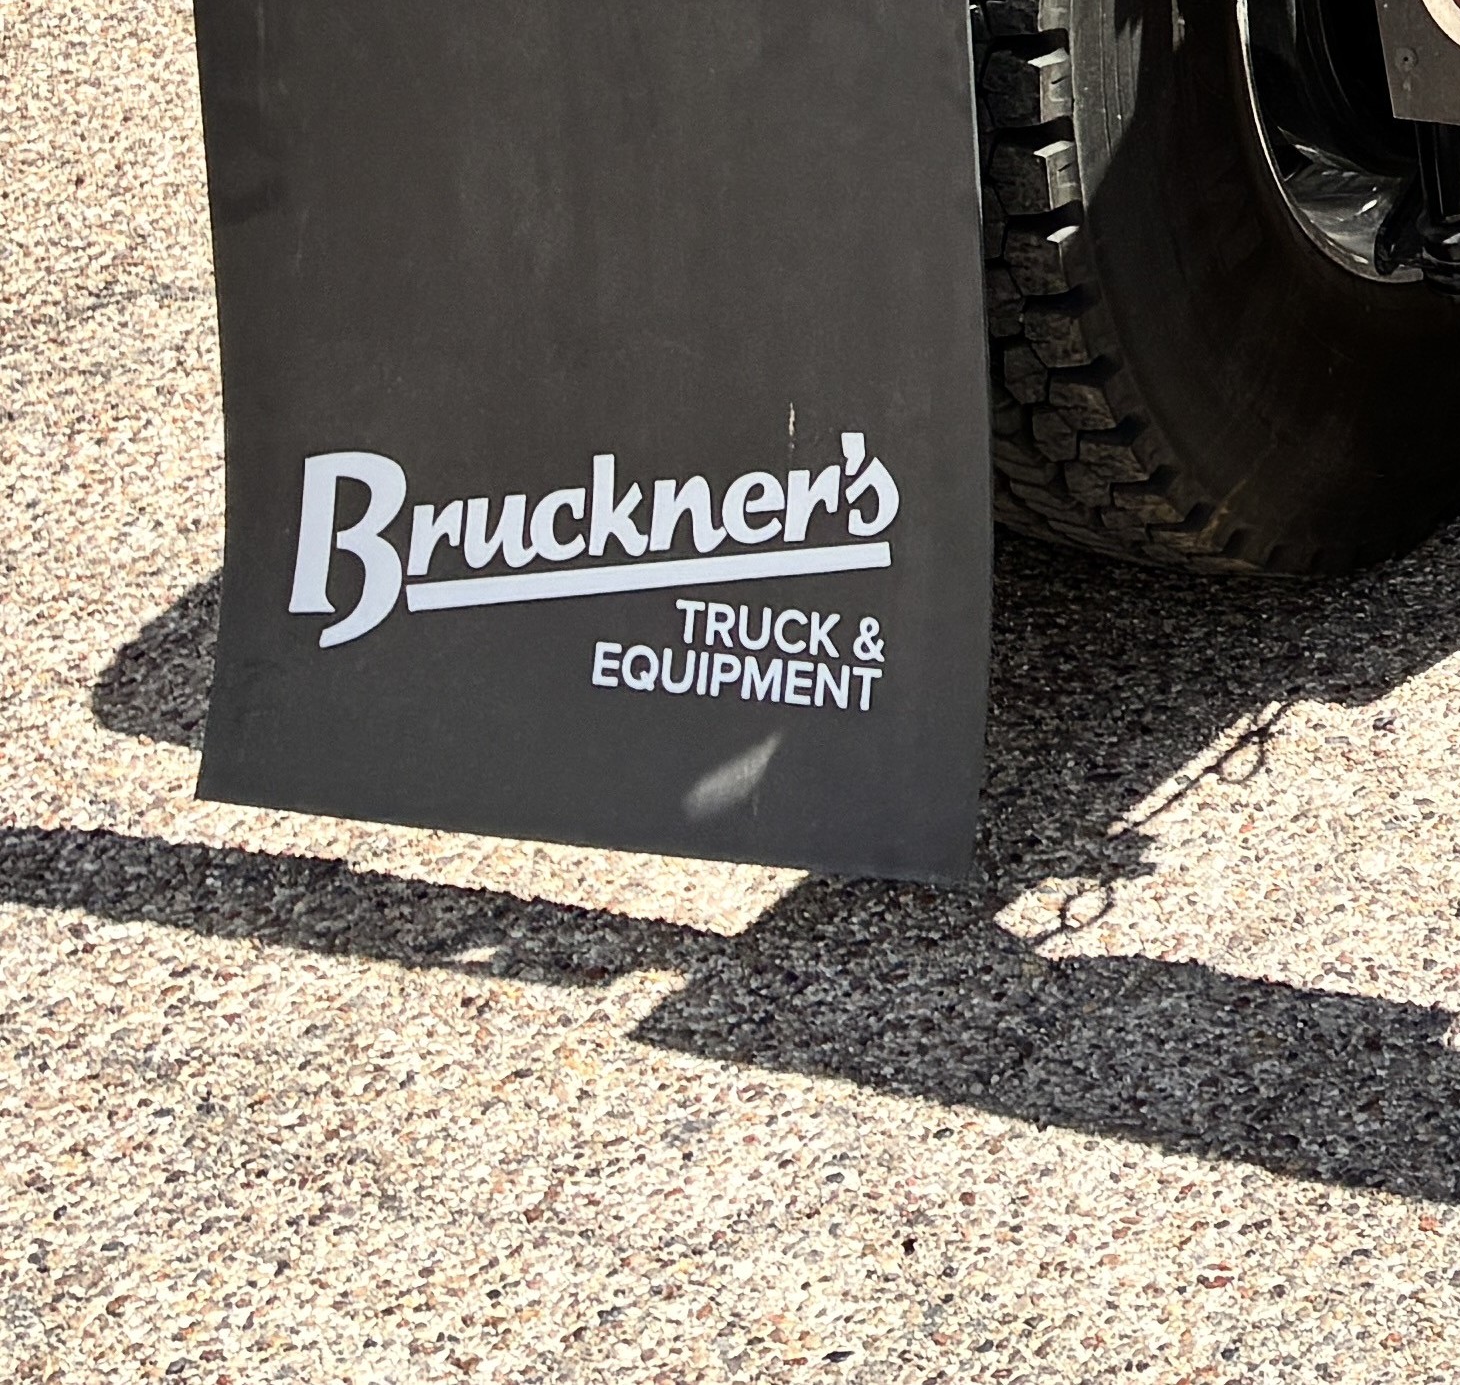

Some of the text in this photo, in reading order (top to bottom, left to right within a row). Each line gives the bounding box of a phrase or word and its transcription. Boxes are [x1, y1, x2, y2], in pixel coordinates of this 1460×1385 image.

[288, 432, 900, 648] Bruckner's
[675, 598, 886, 663] TRUCK &
[591, 641, 884, 712] EQUIPMENT
